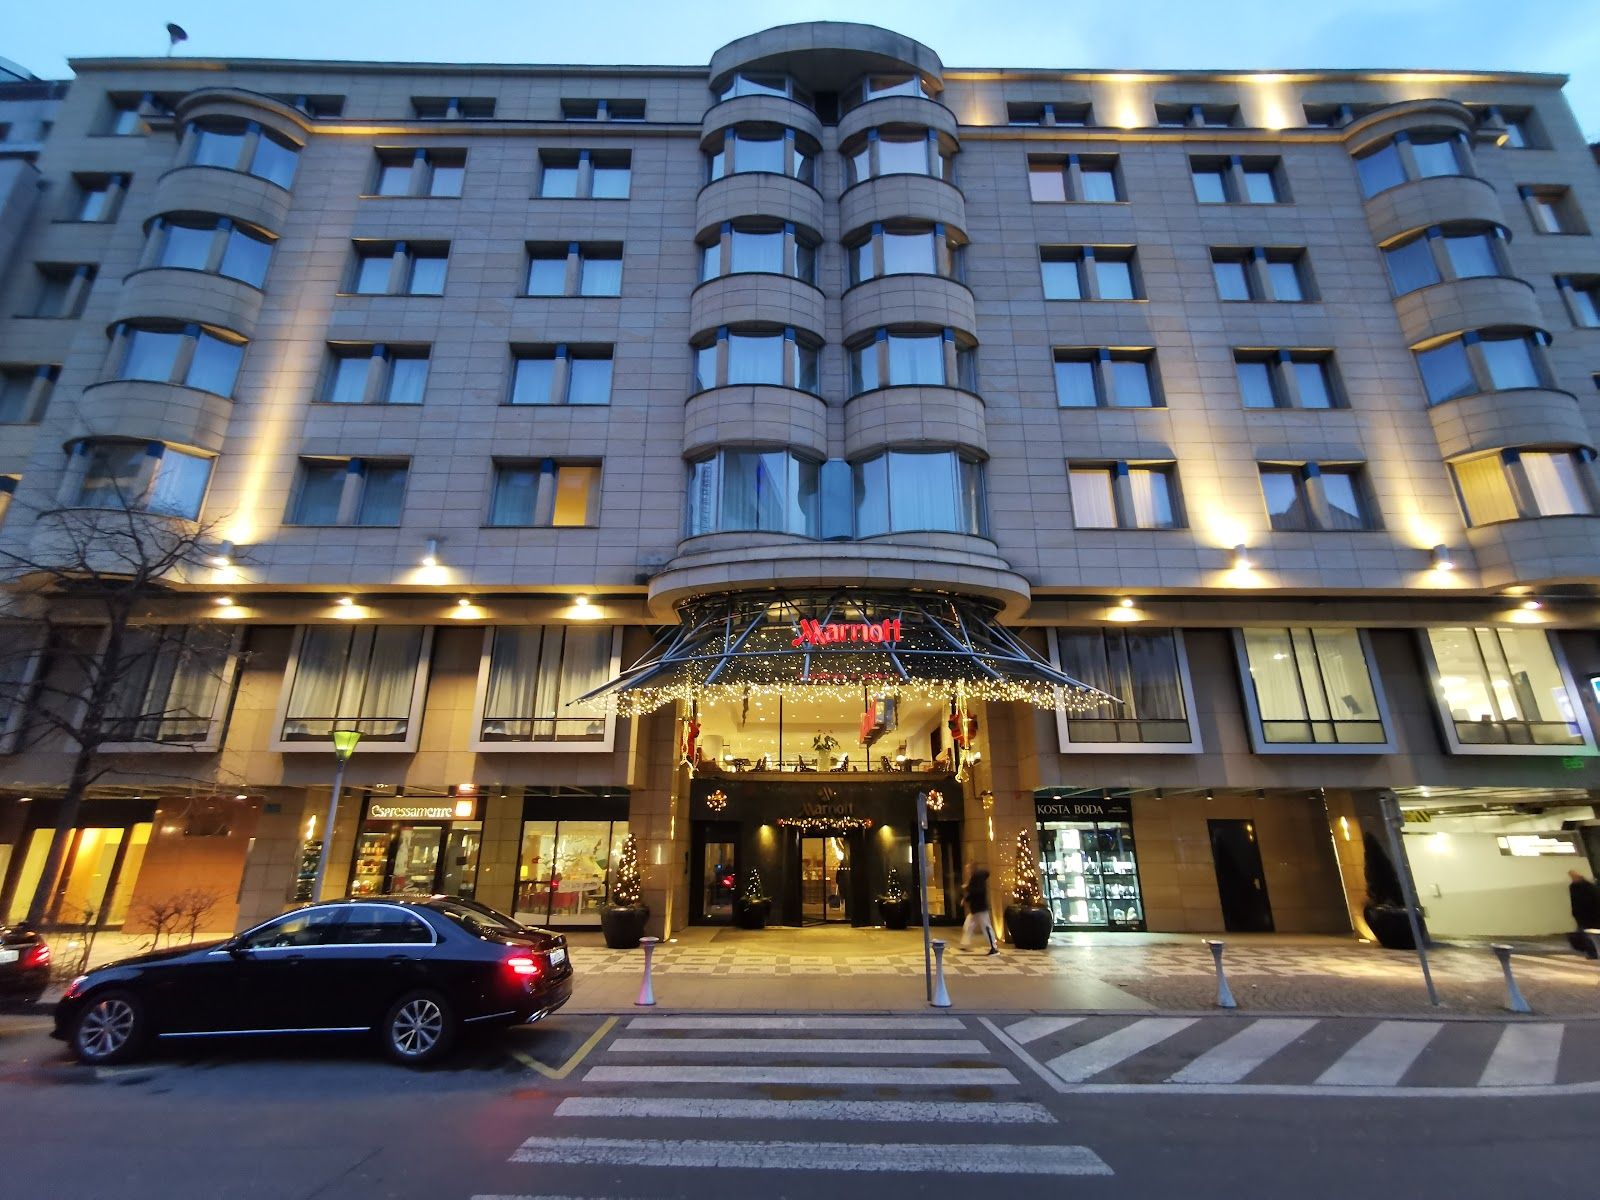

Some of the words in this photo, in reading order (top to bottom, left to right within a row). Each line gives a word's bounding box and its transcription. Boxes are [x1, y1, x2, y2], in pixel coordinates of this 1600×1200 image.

[792, 618, 903, 646] Marriott
[1037, 804, 1071, 815] KOSTA
[1074, 804, 1104, 815] BODA
